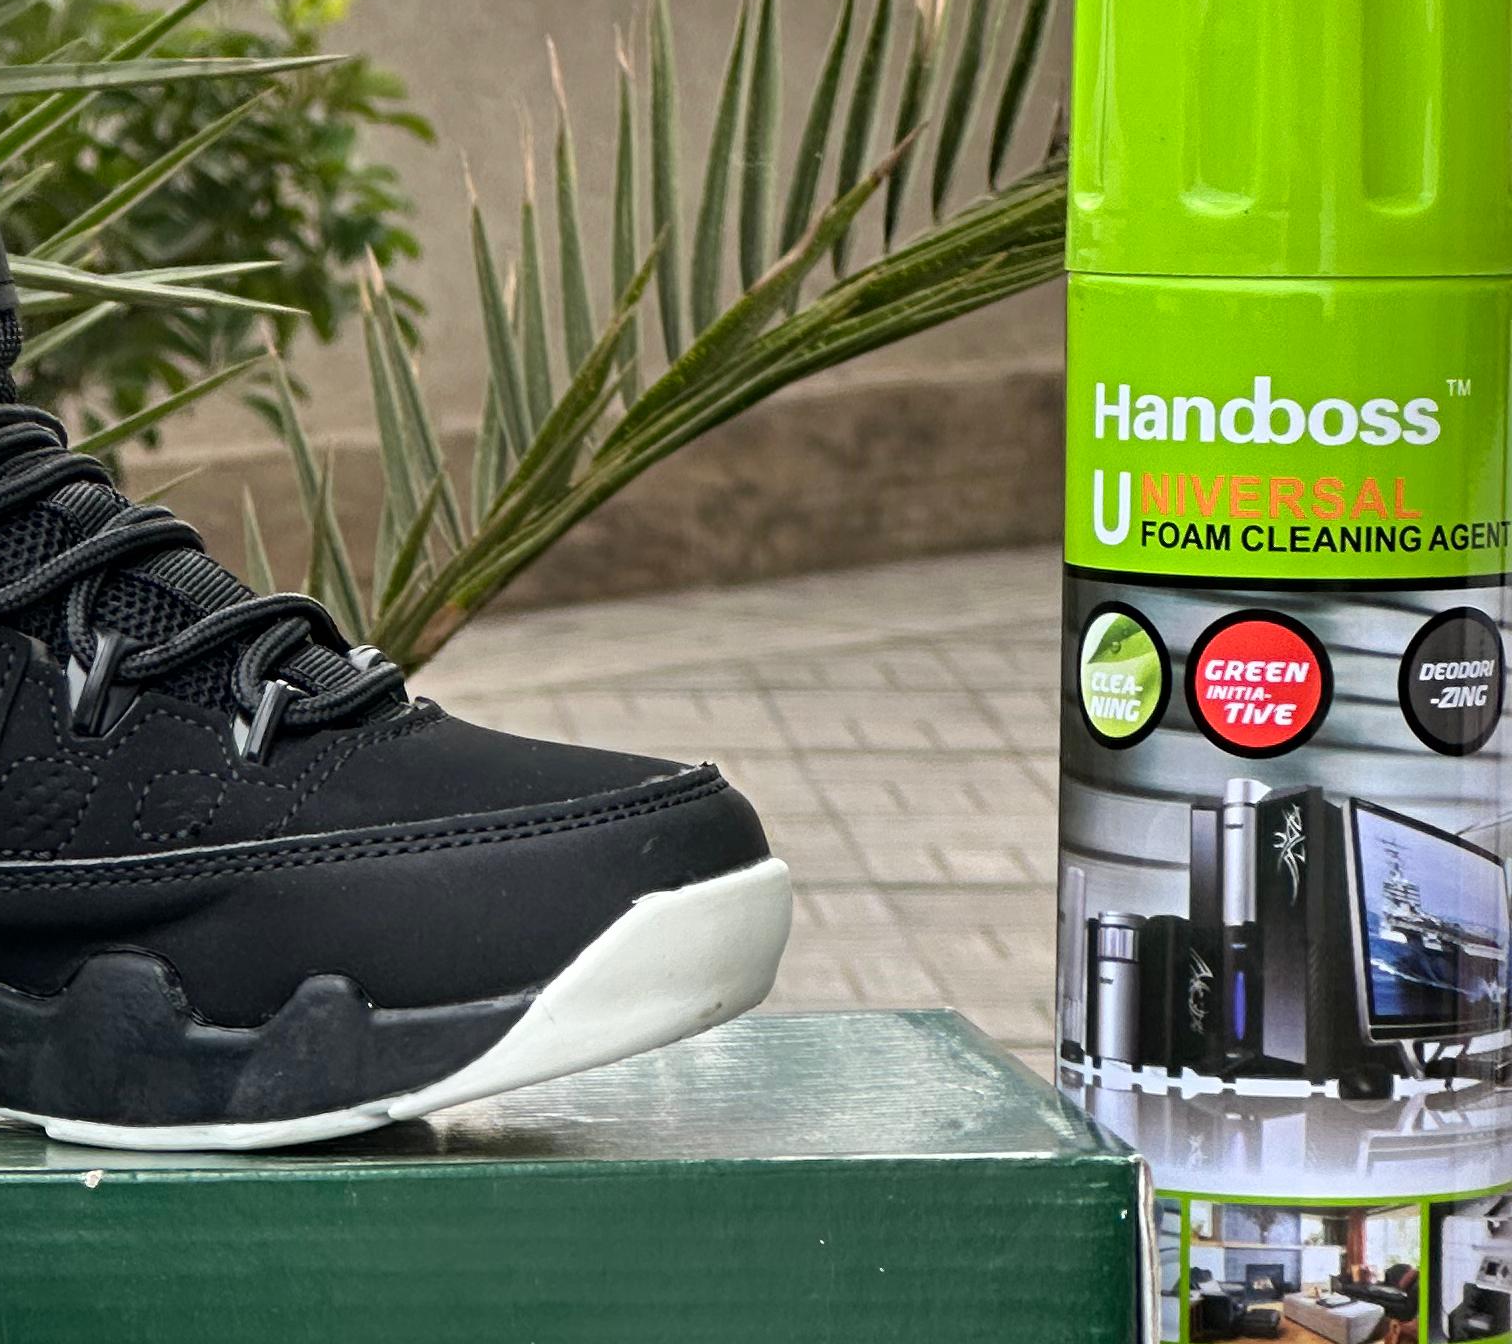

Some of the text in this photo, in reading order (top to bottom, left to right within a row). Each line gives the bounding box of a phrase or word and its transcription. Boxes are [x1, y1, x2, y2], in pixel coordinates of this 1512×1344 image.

[1094, 376, 1441, 446] Handboss
[1093, 469, 1422, 546] UNIVERSAL
[1141, 520, 1511, 553] FOAM CLEANING AGENT
[1204, 659, 1310, 683] GREEN
[1419, 659, 1495, 681] DEODORI
[1091, 671, 1143, 695] CLEA-
[1205, 685, 1272, 702] INITIA-
[1430, 684, 1489, 709] -ZING
[1090, 696, 1141, 722] NING
[1224, 702, 1297, 726] TIVE
